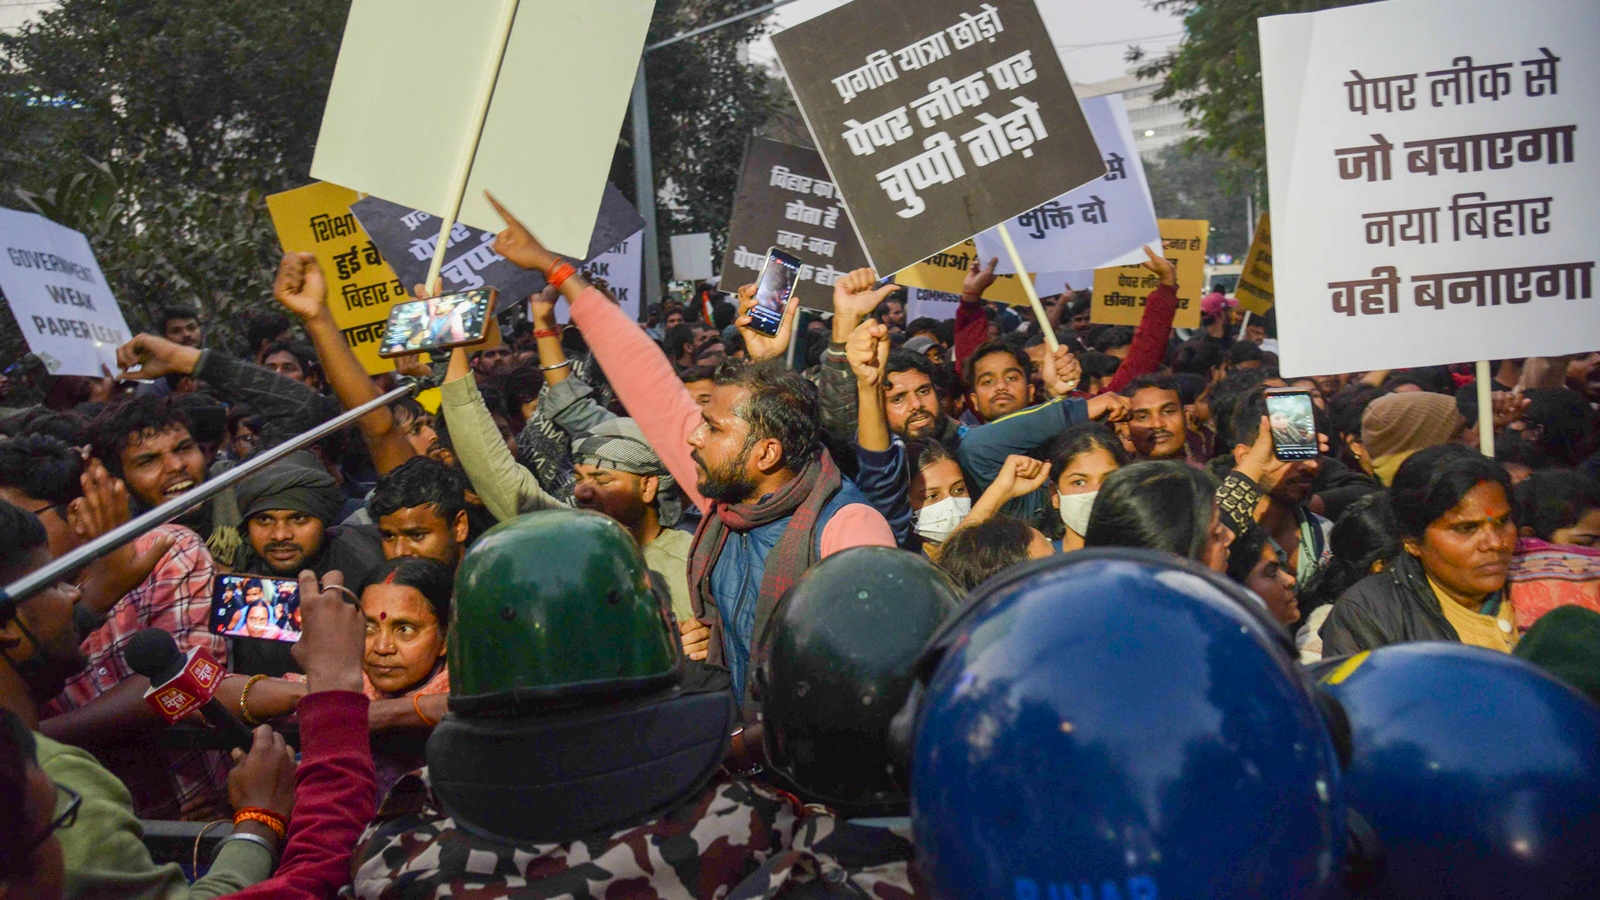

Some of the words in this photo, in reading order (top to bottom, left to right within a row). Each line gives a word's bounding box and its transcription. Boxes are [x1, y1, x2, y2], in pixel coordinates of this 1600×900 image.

[831, 48, 899, 104] प्रगति
[893, 30, 951, 73] यात्रा
[945, 2, 1004, 44] छोड़ो
[841, 105, 914, 157] पेपर
[909, 76, 990, 128] लीक
[986, 49, 1038, 91] पर
[1344, 69, 1418, 116] पेपर
[1425, 55, 1513, 108] लीक
[1520, 47, 1561, 98] से
[875, 131, 966, 219] चुप्पी
[960, 95, 1049, 167] तोड़ो
[1334, 133, 1394, 183] जो
[1403, 124, 1578, 177] बचाएगा
[310, 213, 357, 243] शिक्षा
[1077, 195, 1109, 225] दो
[1362, 206, 1441, 248] नया
[1448, 191, 1554, 242] बिहार
[7, 247, 97, 285] GOVERNMENT
[1328, 265, 1401, 317] वही
[1411, 261, 1595, 310] बनाएगा
[45, 284, 98, 312] WEAK
[342, 283, 390, 311] बिहार
[31, 315, 93, 339] PAPER
